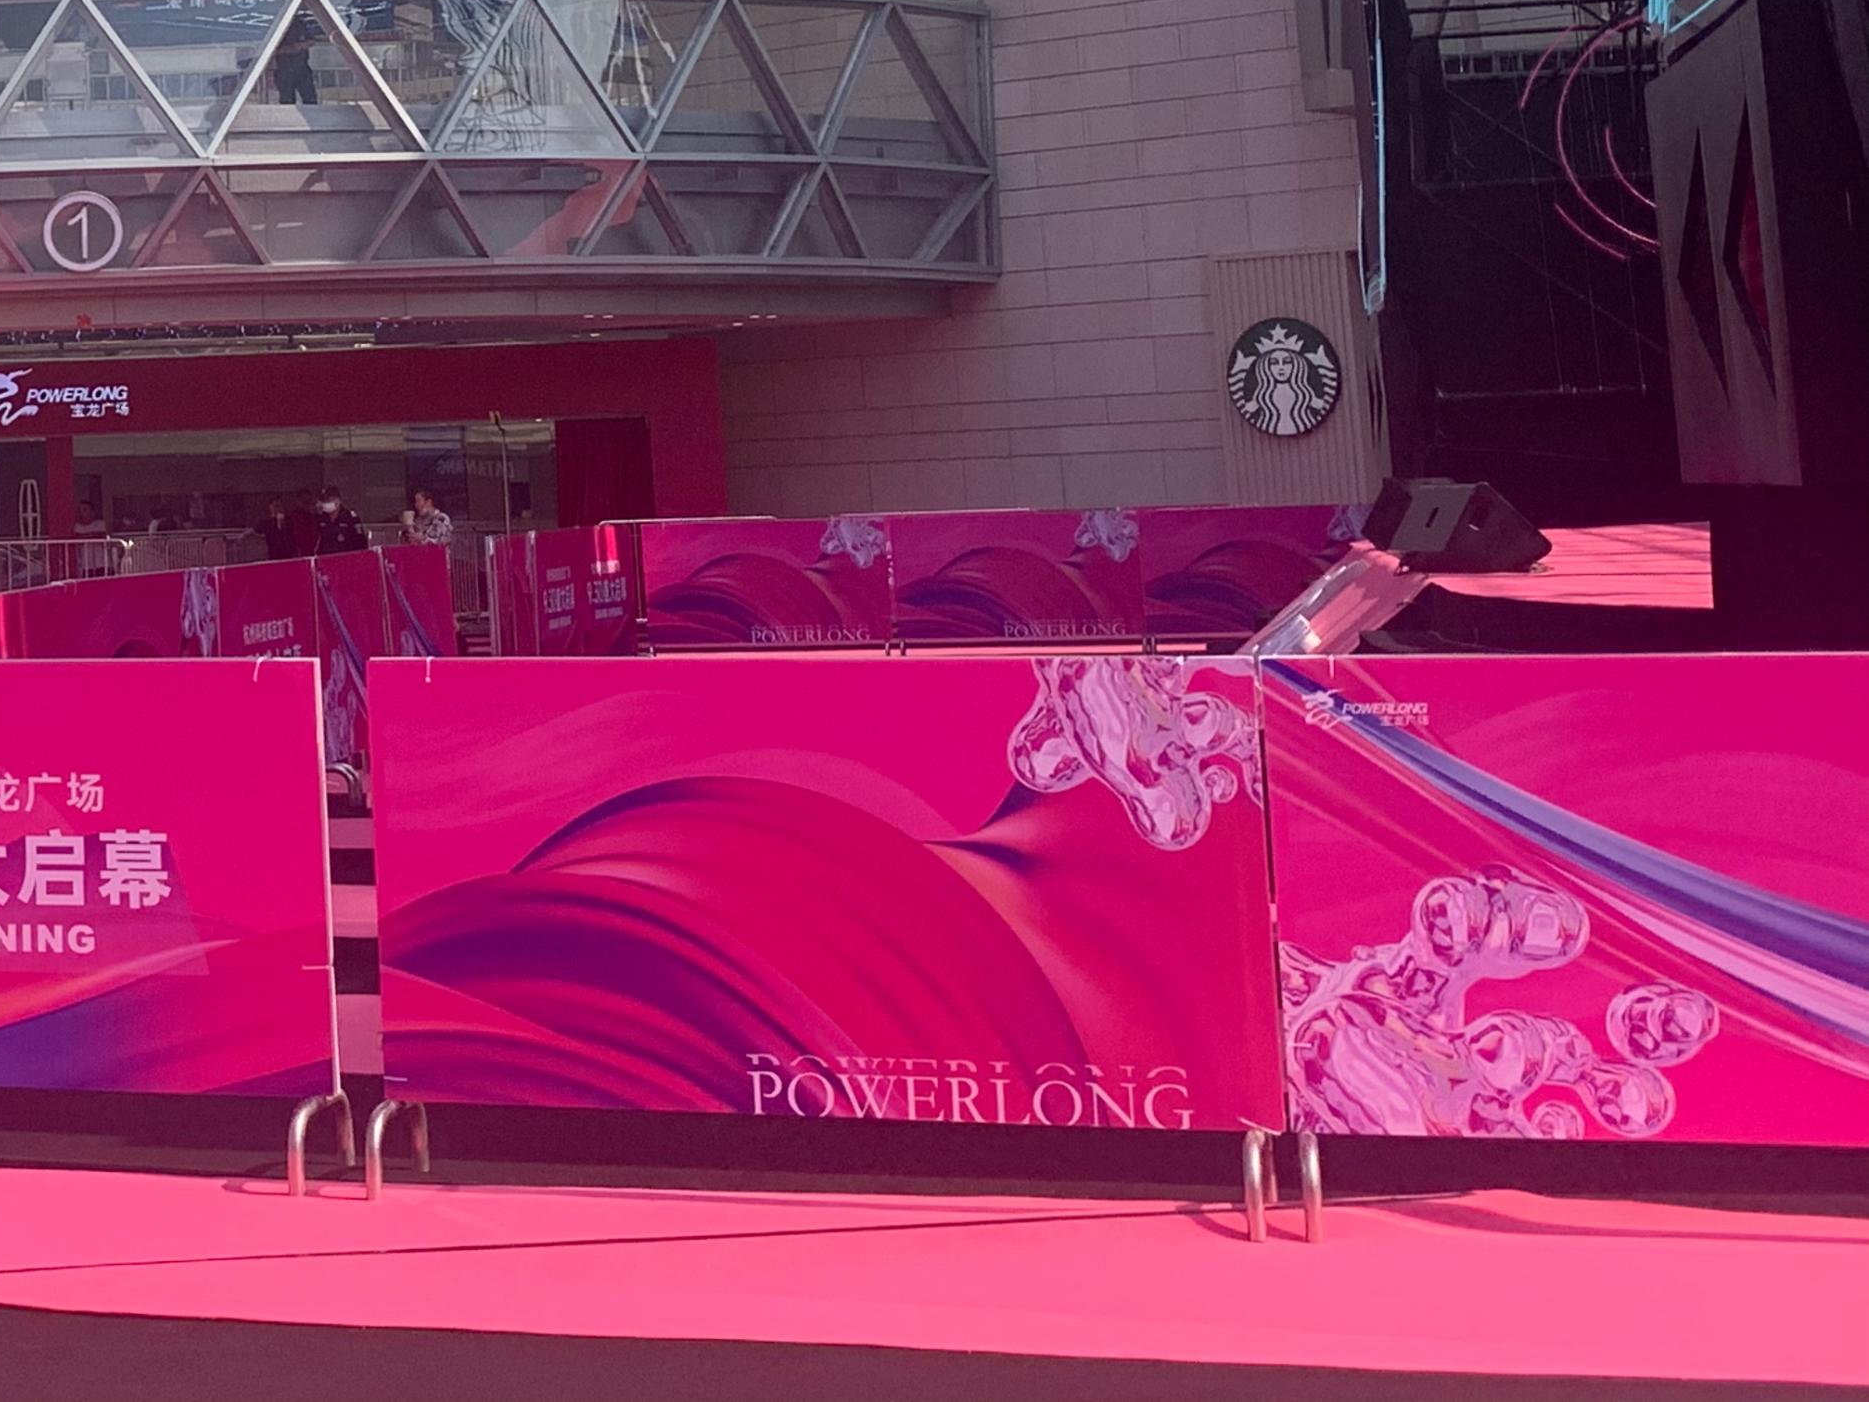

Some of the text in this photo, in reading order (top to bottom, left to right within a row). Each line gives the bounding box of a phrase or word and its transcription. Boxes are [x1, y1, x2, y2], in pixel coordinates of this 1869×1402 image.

[26, 385, 129, 403] POWERLONG
[70, 402, 129, 418] 宝龙广场
[750, 625, 870, 644] POWERLONG
[1003, 621, 1126, 639] POWERLONG
[1342, 702, 1428, 715] POWERLONG
[745, 1070, 1194, 1130] POWERLONG
